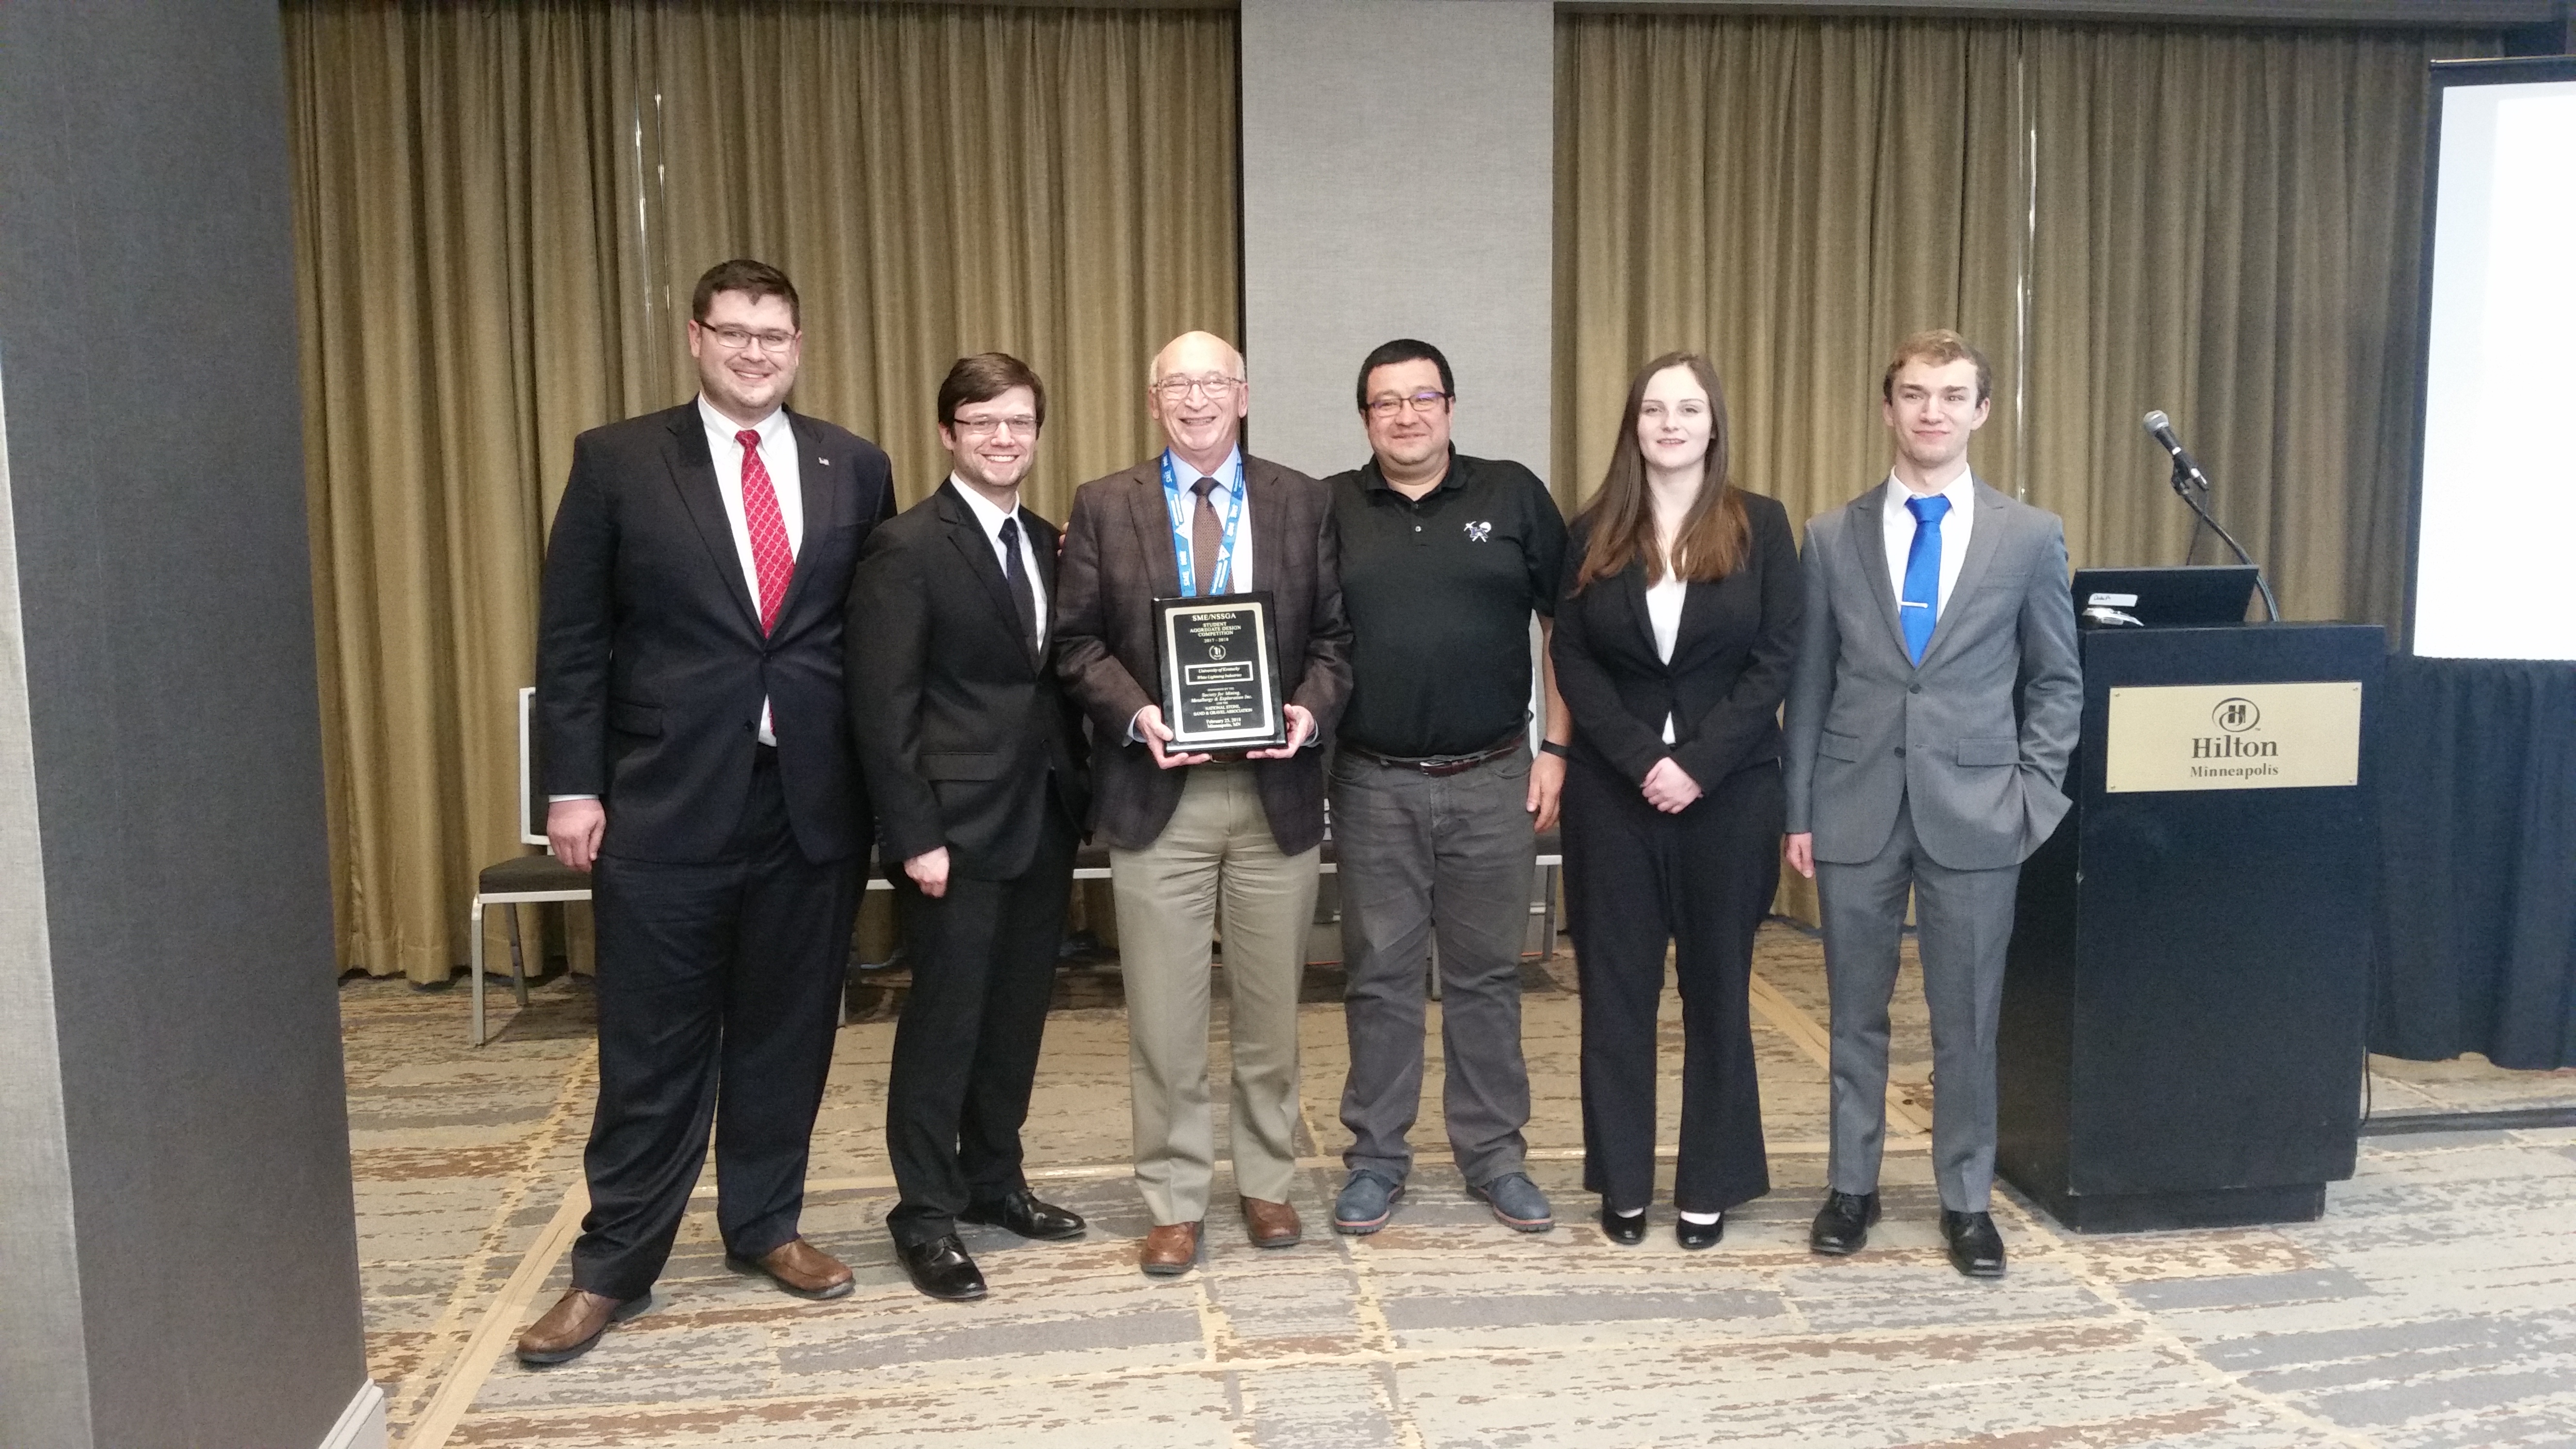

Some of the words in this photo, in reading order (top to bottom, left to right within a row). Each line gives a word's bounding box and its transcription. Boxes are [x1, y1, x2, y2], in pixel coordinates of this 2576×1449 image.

[1191, 612, 1237, 622] SME/NSSGA
[2191, 735, 2279, 758] Hilton
[2190, 763, 2279, 780] Minneapolis
